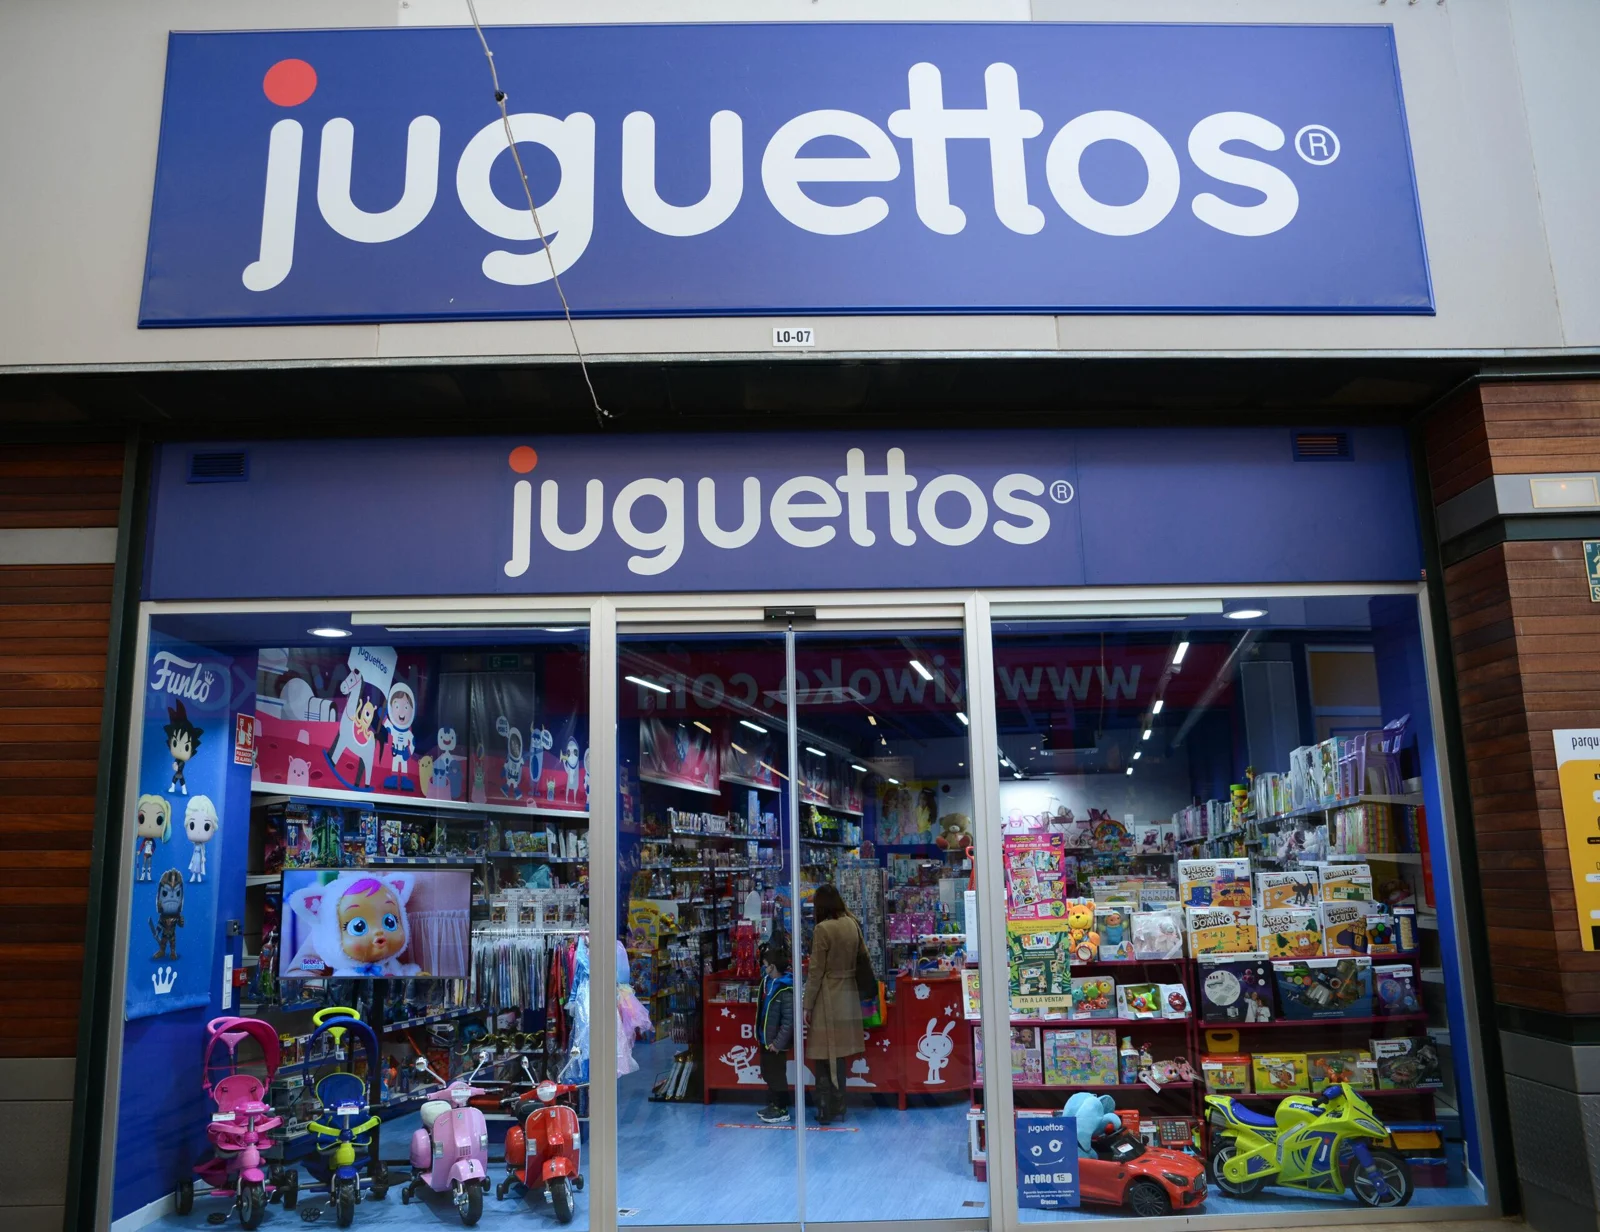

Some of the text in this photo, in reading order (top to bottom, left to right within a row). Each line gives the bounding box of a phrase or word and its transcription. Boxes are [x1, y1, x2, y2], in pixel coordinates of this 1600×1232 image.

[151, 651, 212, 703] Funko
[1028, 1123, 1064, 1133] juguettos
[1024, 1174, 1065, 1184] AFORO 15
